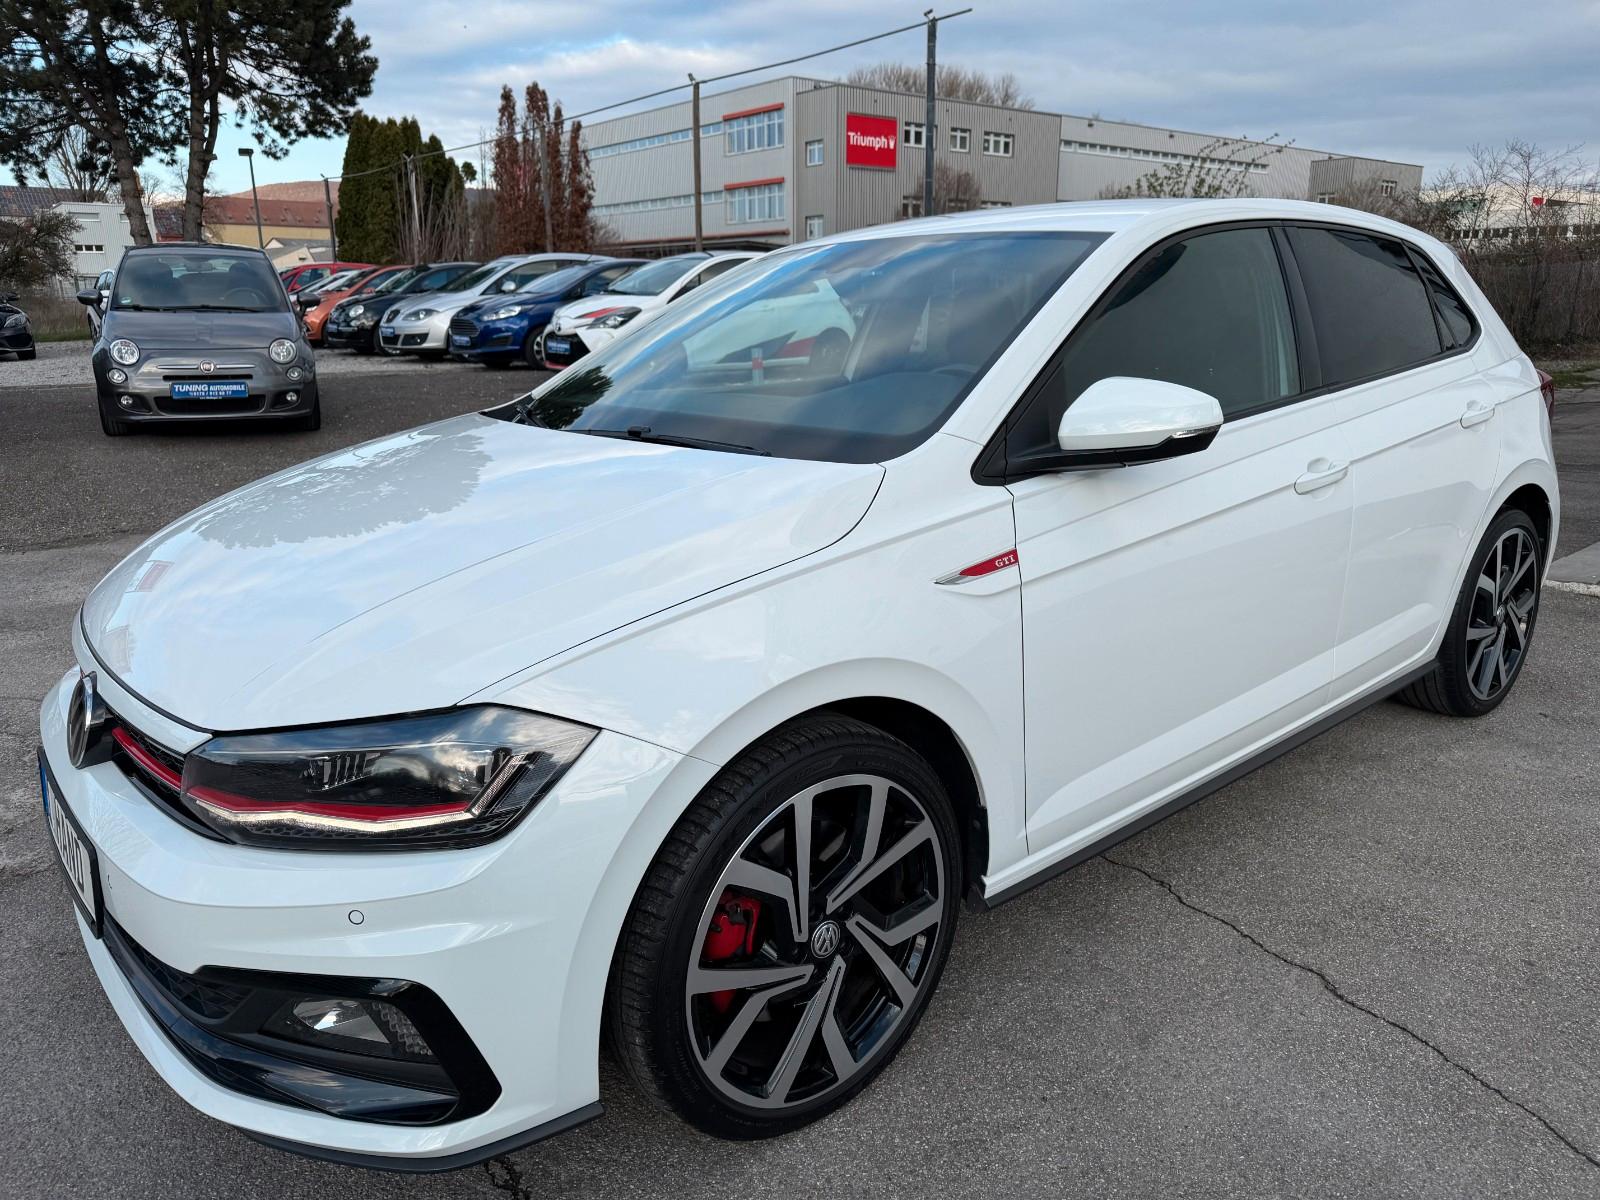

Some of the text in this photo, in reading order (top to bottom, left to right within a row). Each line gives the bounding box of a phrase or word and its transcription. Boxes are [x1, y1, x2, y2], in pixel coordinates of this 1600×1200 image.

[848, 132, 887, 151] Triumph
[174, 384, 208, 392] TUNING
[995, 554, 1016, 567] GTI
